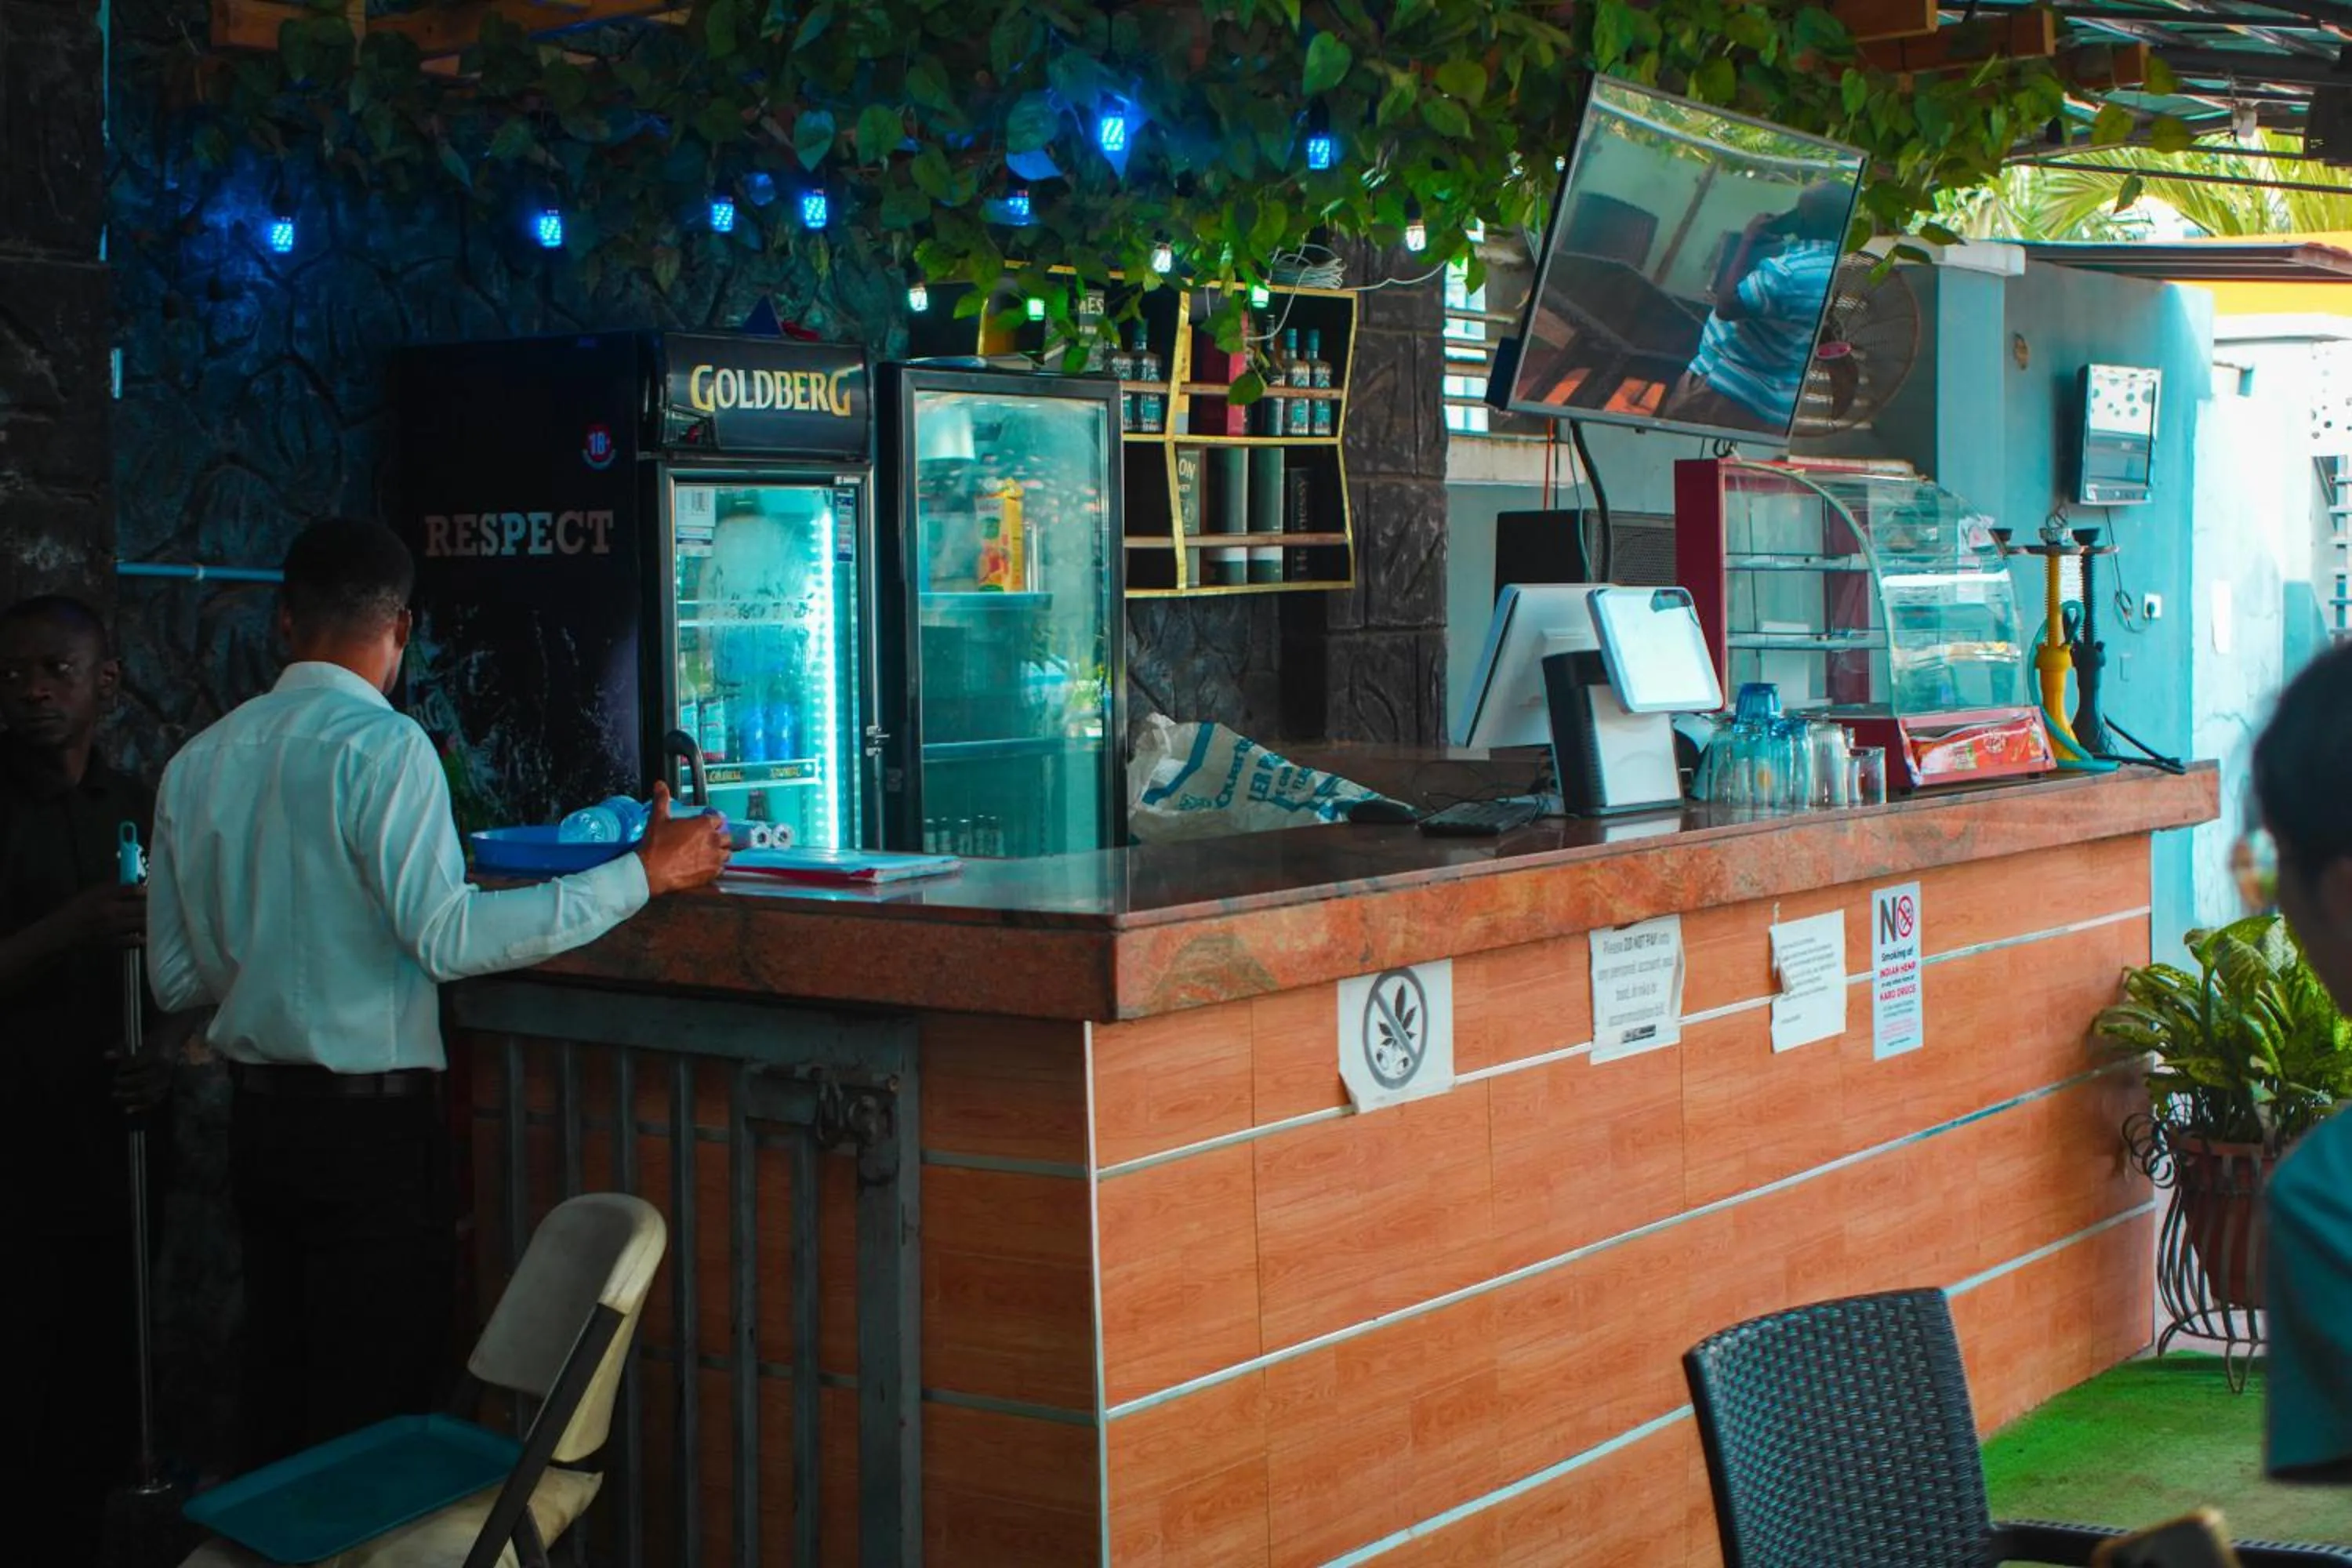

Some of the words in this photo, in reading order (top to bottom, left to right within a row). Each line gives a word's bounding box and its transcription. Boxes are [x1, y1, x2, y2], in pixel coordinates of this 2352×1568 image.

[690, 365, 851, 416] GOLDBERG
[425, 510, 614, 557] RESPECT
[1882, 948, 1905, 962] Smoking
[1880, 965, 1899, 978] INDIAN
[1880, 989, 1896, 1001] HARD
